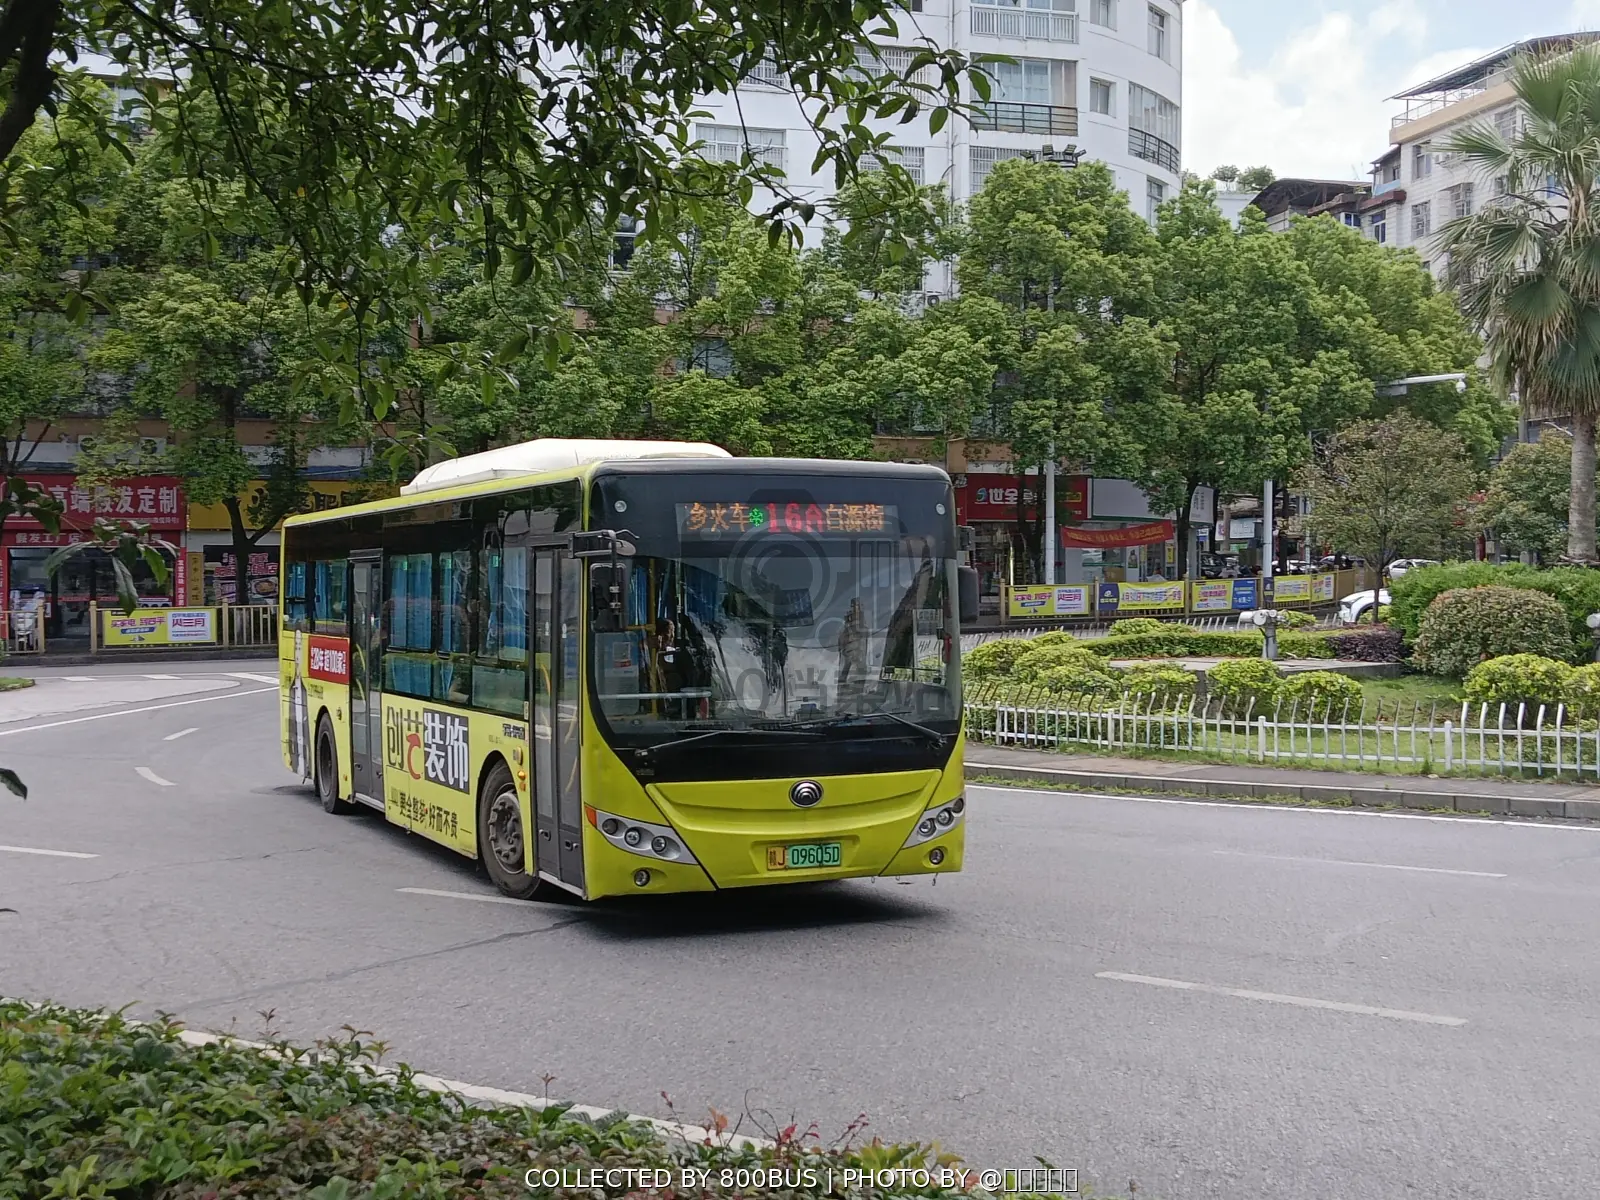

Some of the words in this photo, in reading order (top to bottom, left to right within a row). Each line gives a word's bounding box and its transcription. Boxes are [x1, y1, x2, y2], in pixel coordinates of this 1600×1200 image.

[766, 502, 824, 533] 16A
[386, 705, 469, 790] 创艺装饰
